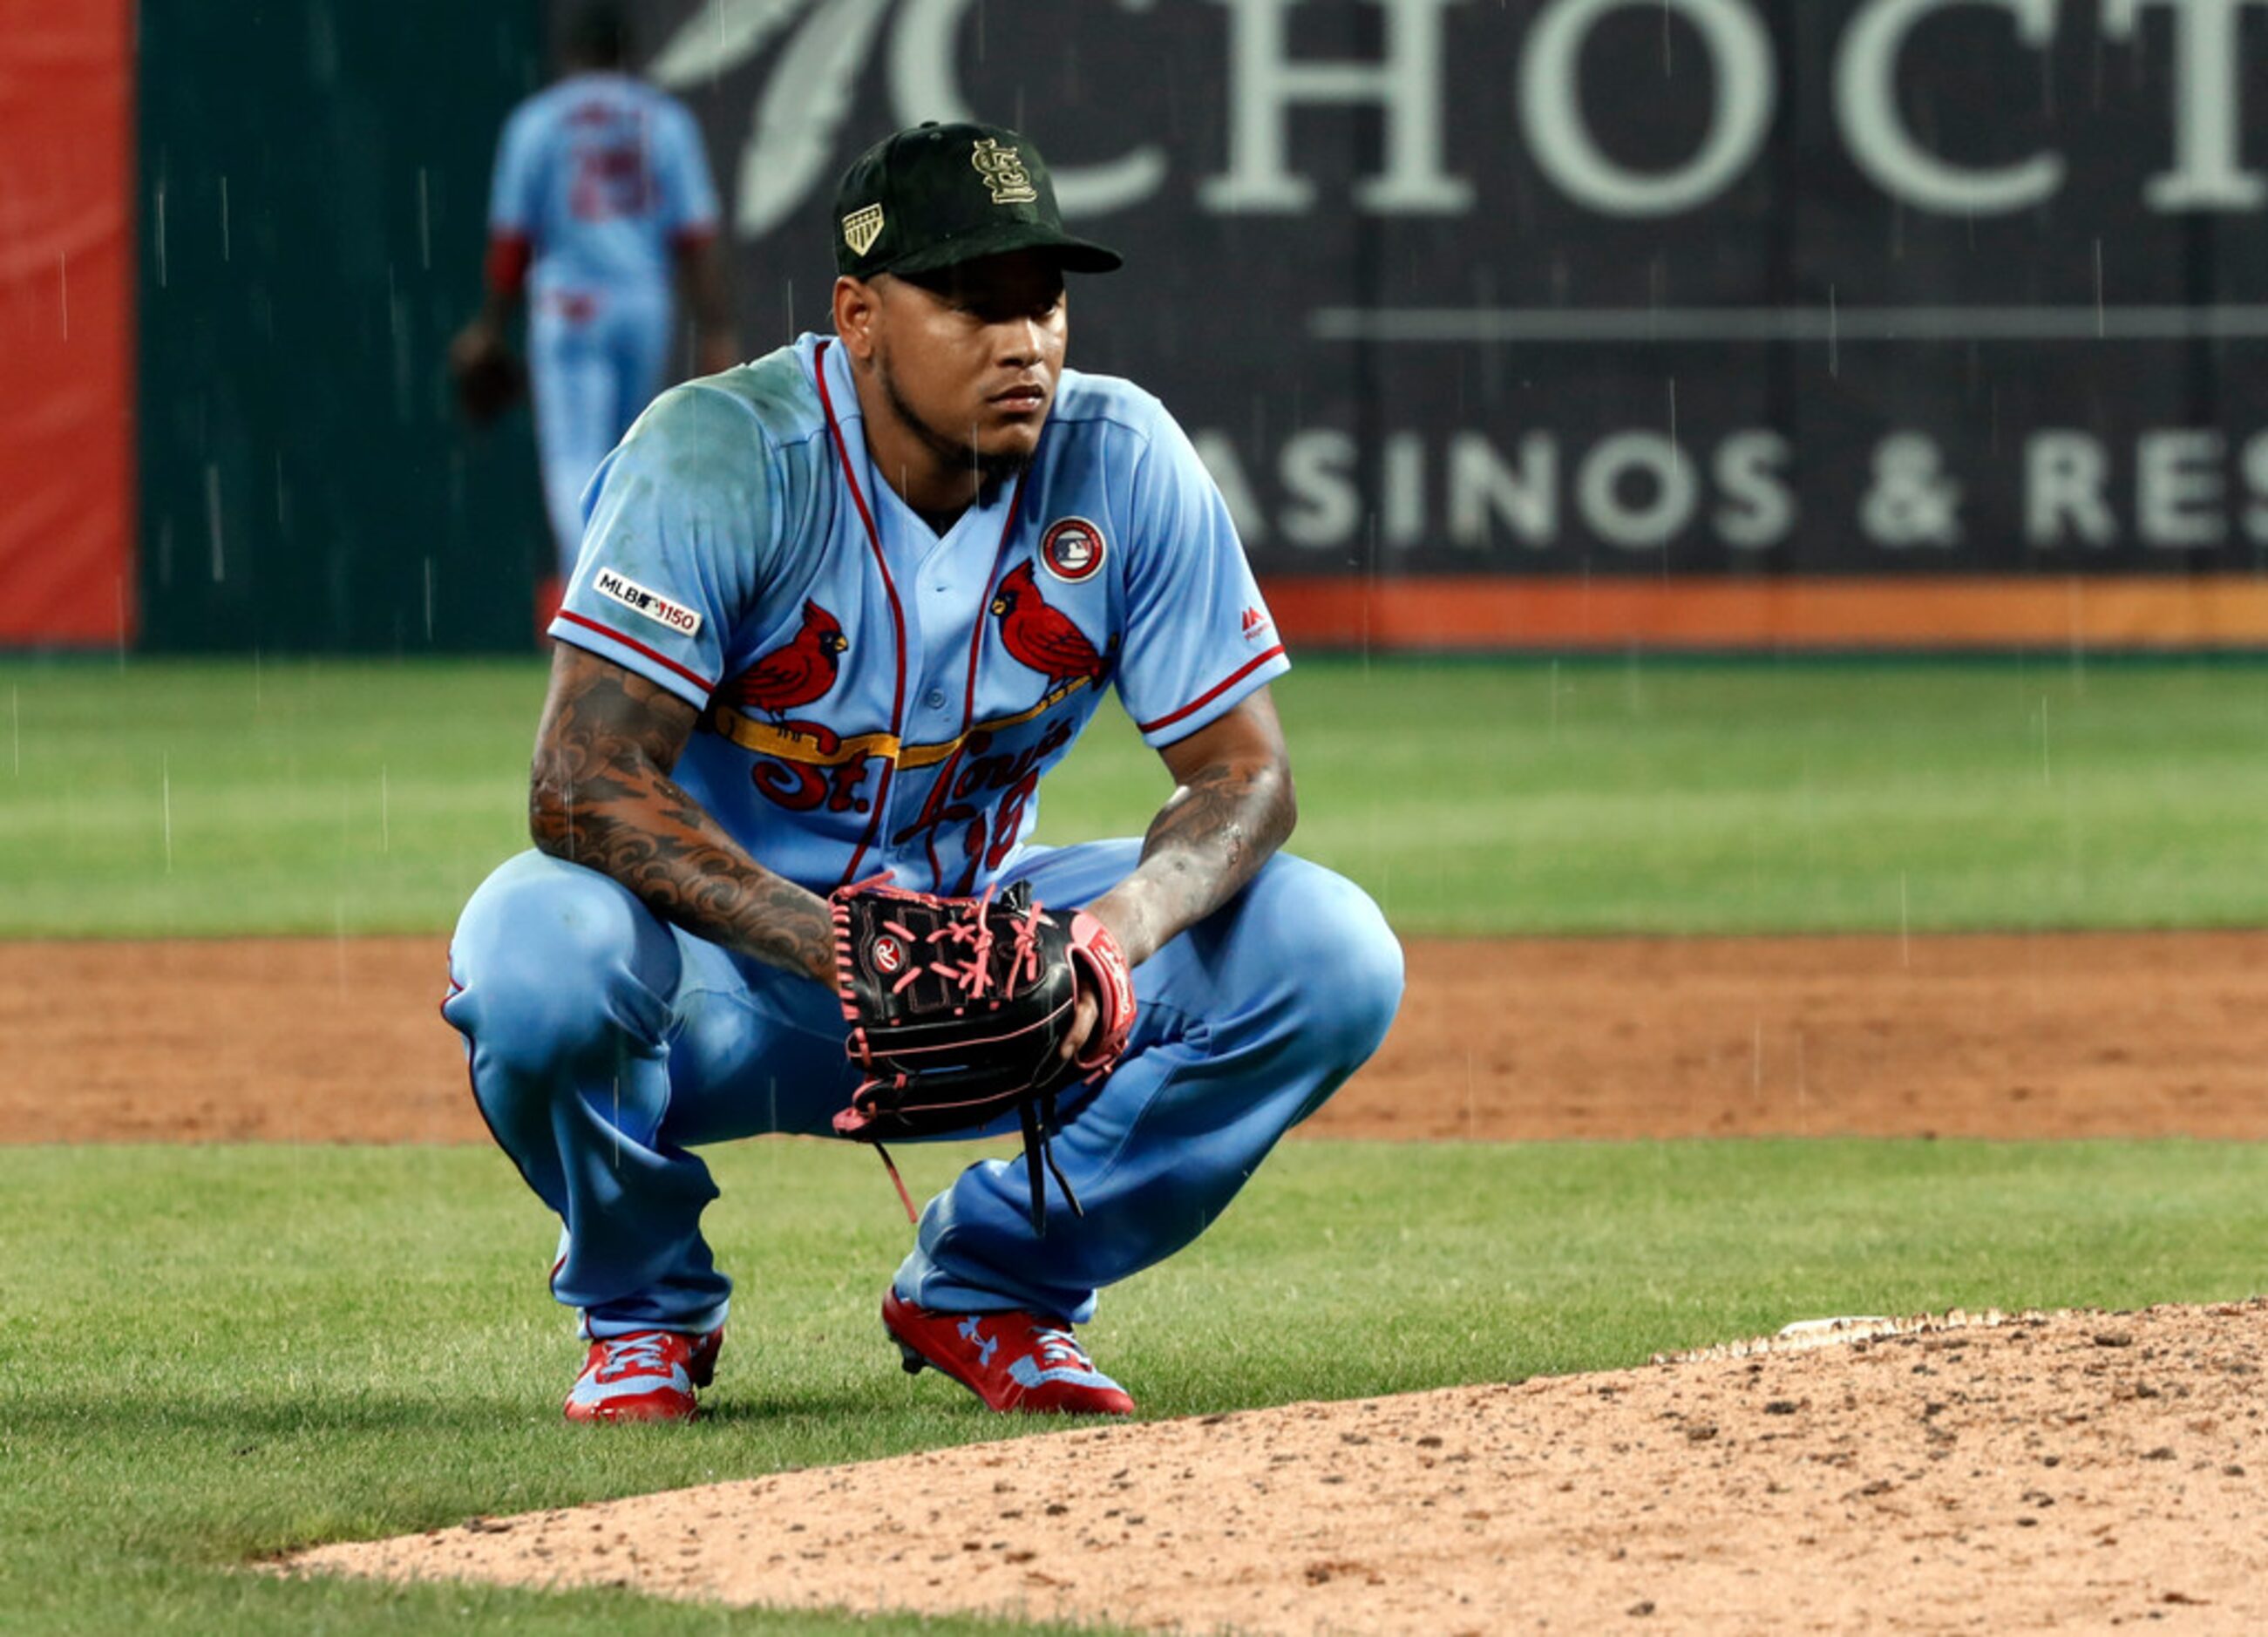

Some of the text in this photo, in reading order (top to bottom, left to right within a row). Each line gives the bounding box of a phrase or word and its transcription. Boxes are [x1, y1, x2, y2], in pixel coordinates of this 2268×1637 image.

[1862, 431, 1958, 547] &
[599, 573, 695, 630] MLB 150
[892, 716, 1075, 846] Louis
